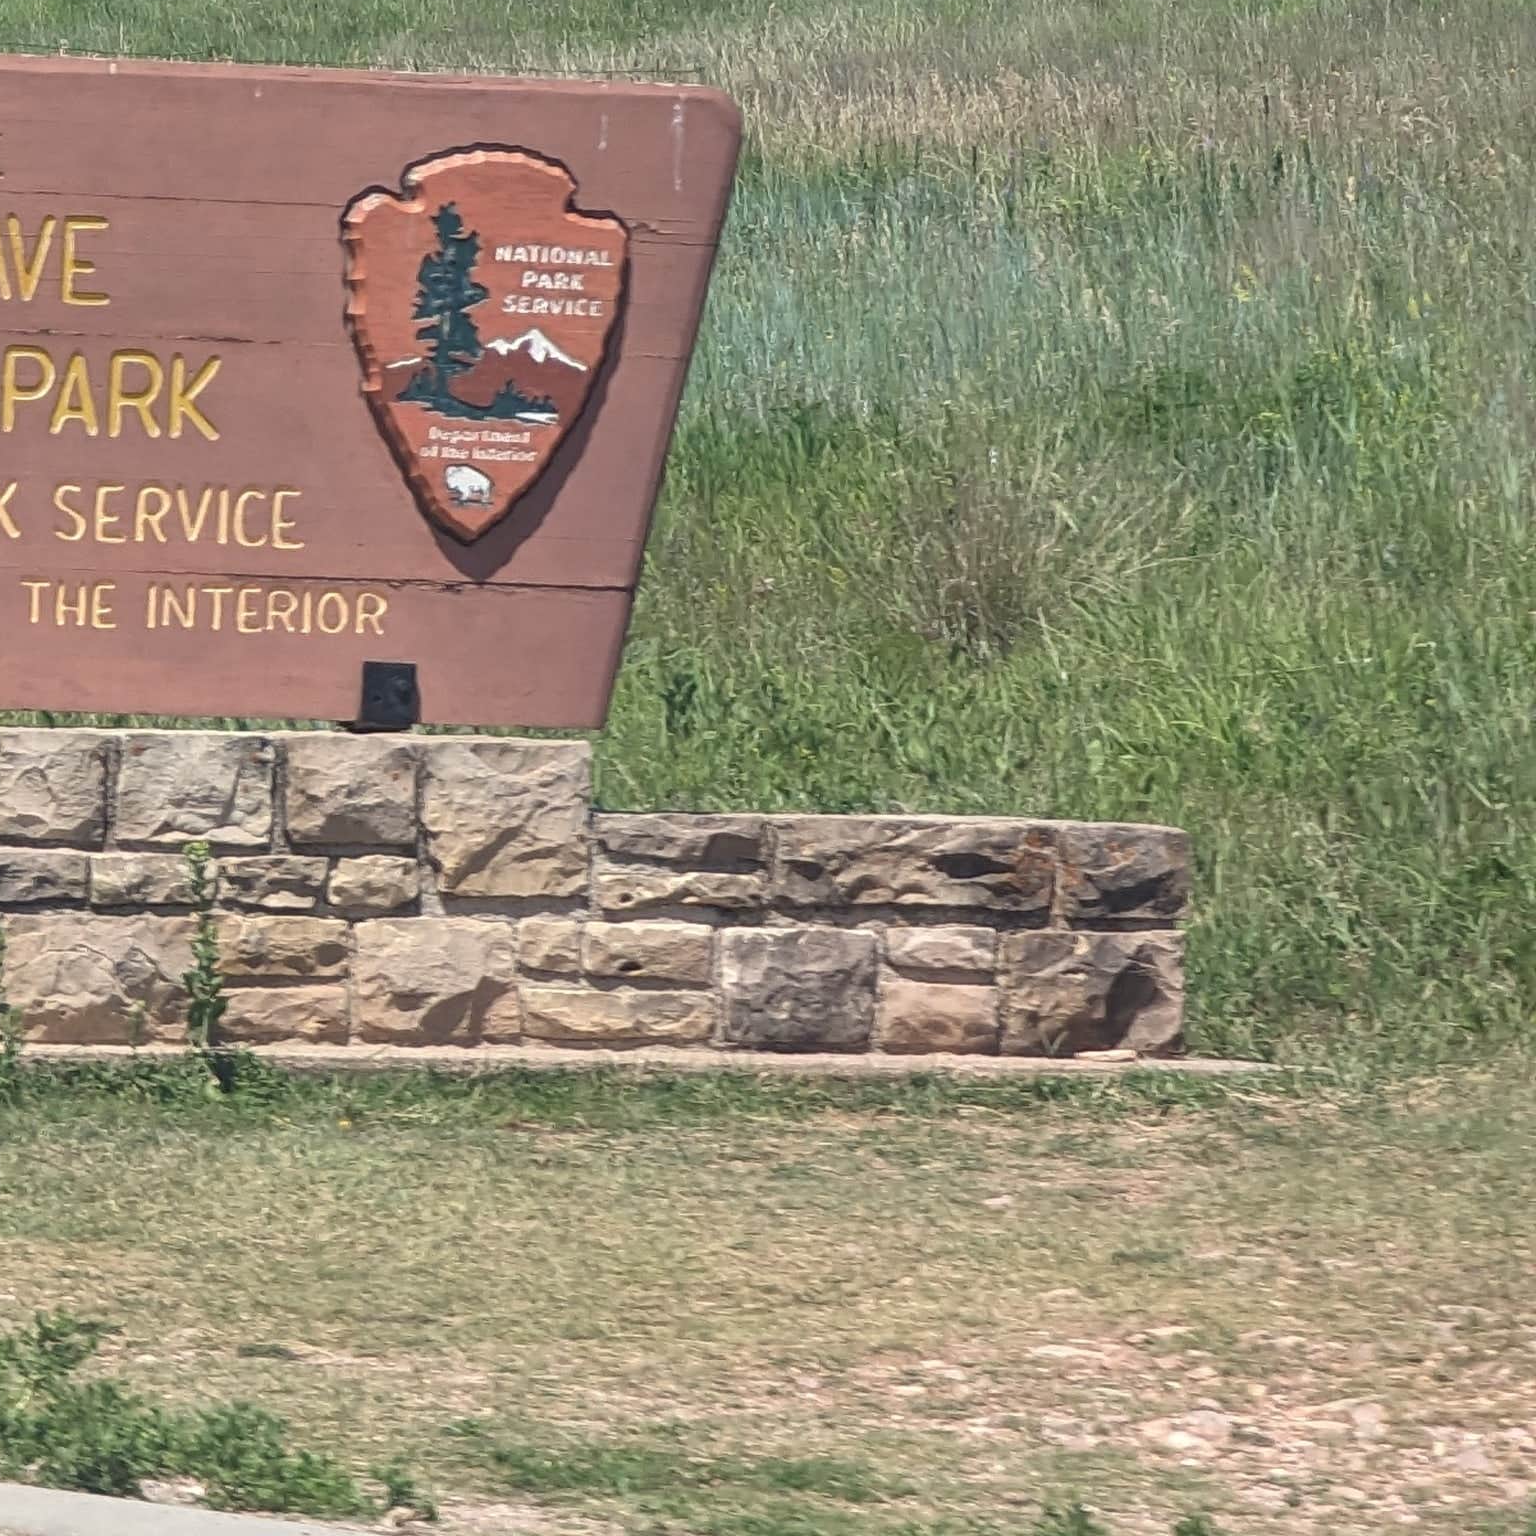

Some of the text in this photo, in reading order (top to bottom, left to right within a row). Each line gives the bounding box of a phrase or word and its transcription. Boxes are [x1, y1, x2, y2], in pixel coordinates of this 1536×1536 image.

[494, 246, 614, 266] NATIONAL
[521, 270, 585, 290] PARK
[501, 294, 603, 317] SERVICE
[1, 344, 222, 441] PARK
[54, 483, 306, 550] SERVICE
[20, 580, 117, 629] THE
[146, 586, 389, 635] INTERIOR
